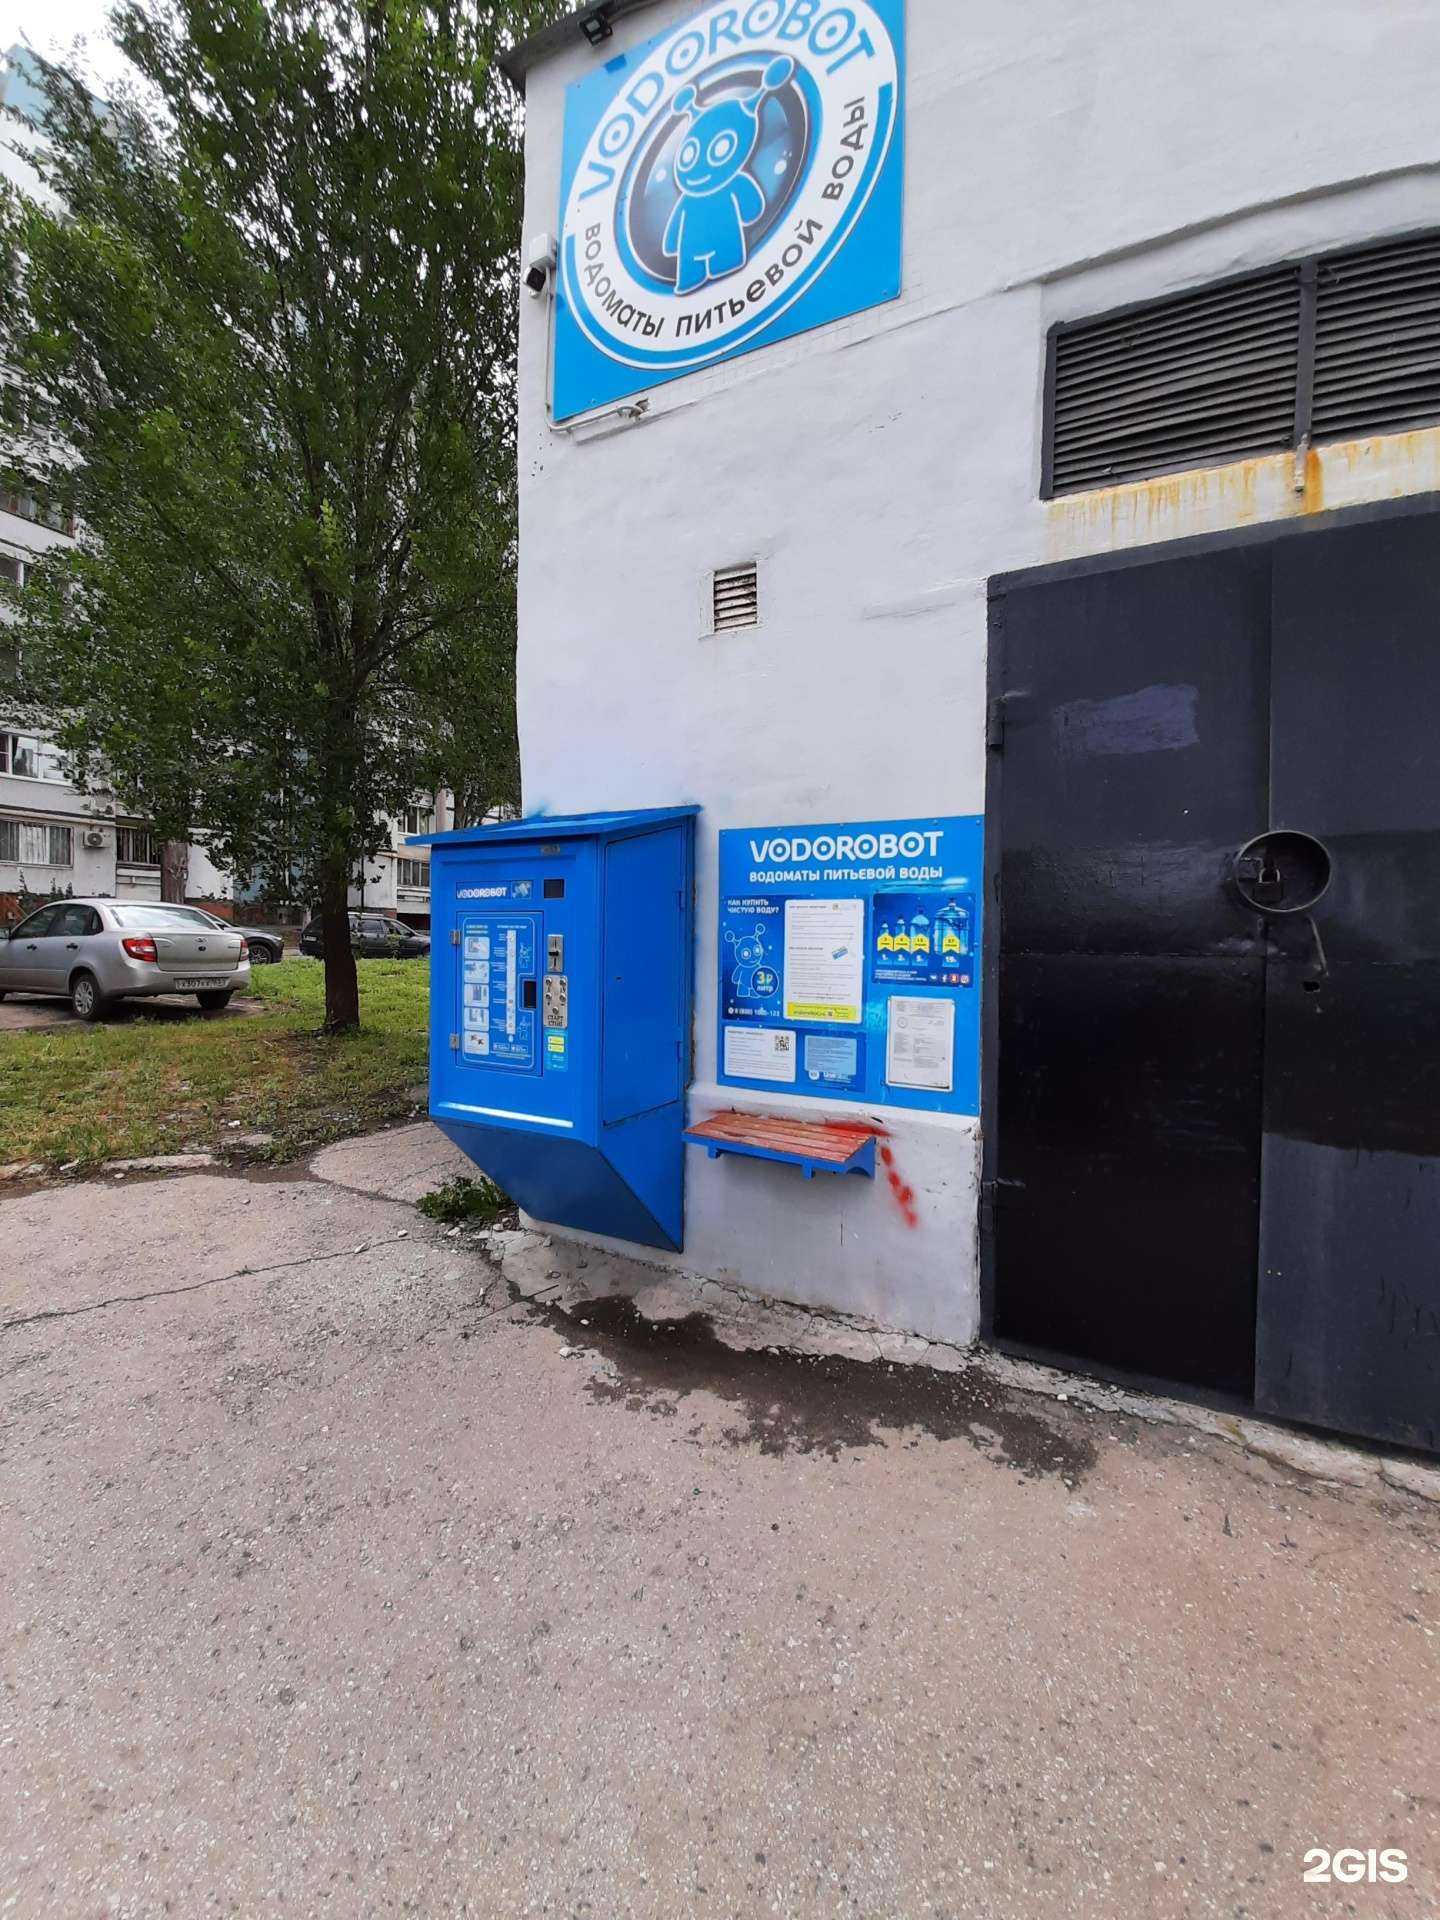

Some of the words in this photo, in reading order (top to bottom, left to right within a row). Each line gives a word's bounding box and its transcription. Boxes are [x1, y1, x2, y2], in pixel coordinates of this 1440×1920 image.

[579, 0, 875, 203] VODOROBOT
[750, 831, 944, 863] VODOROBOT
[749, 869, 820, 883] ВОДОМАТЫ
[823, 865, 896, 881] ПИТЬЕВОЙ
[899, 866, 943, 880] ВОДЫ
[456, 887, 507, 899] VODOROBOT
[742, 898, 769, 906] КУПИТЬ
[727, 906, 755, 914] ЧИСТУЮ
[756, 906, 780, 914] ВОДУ?
